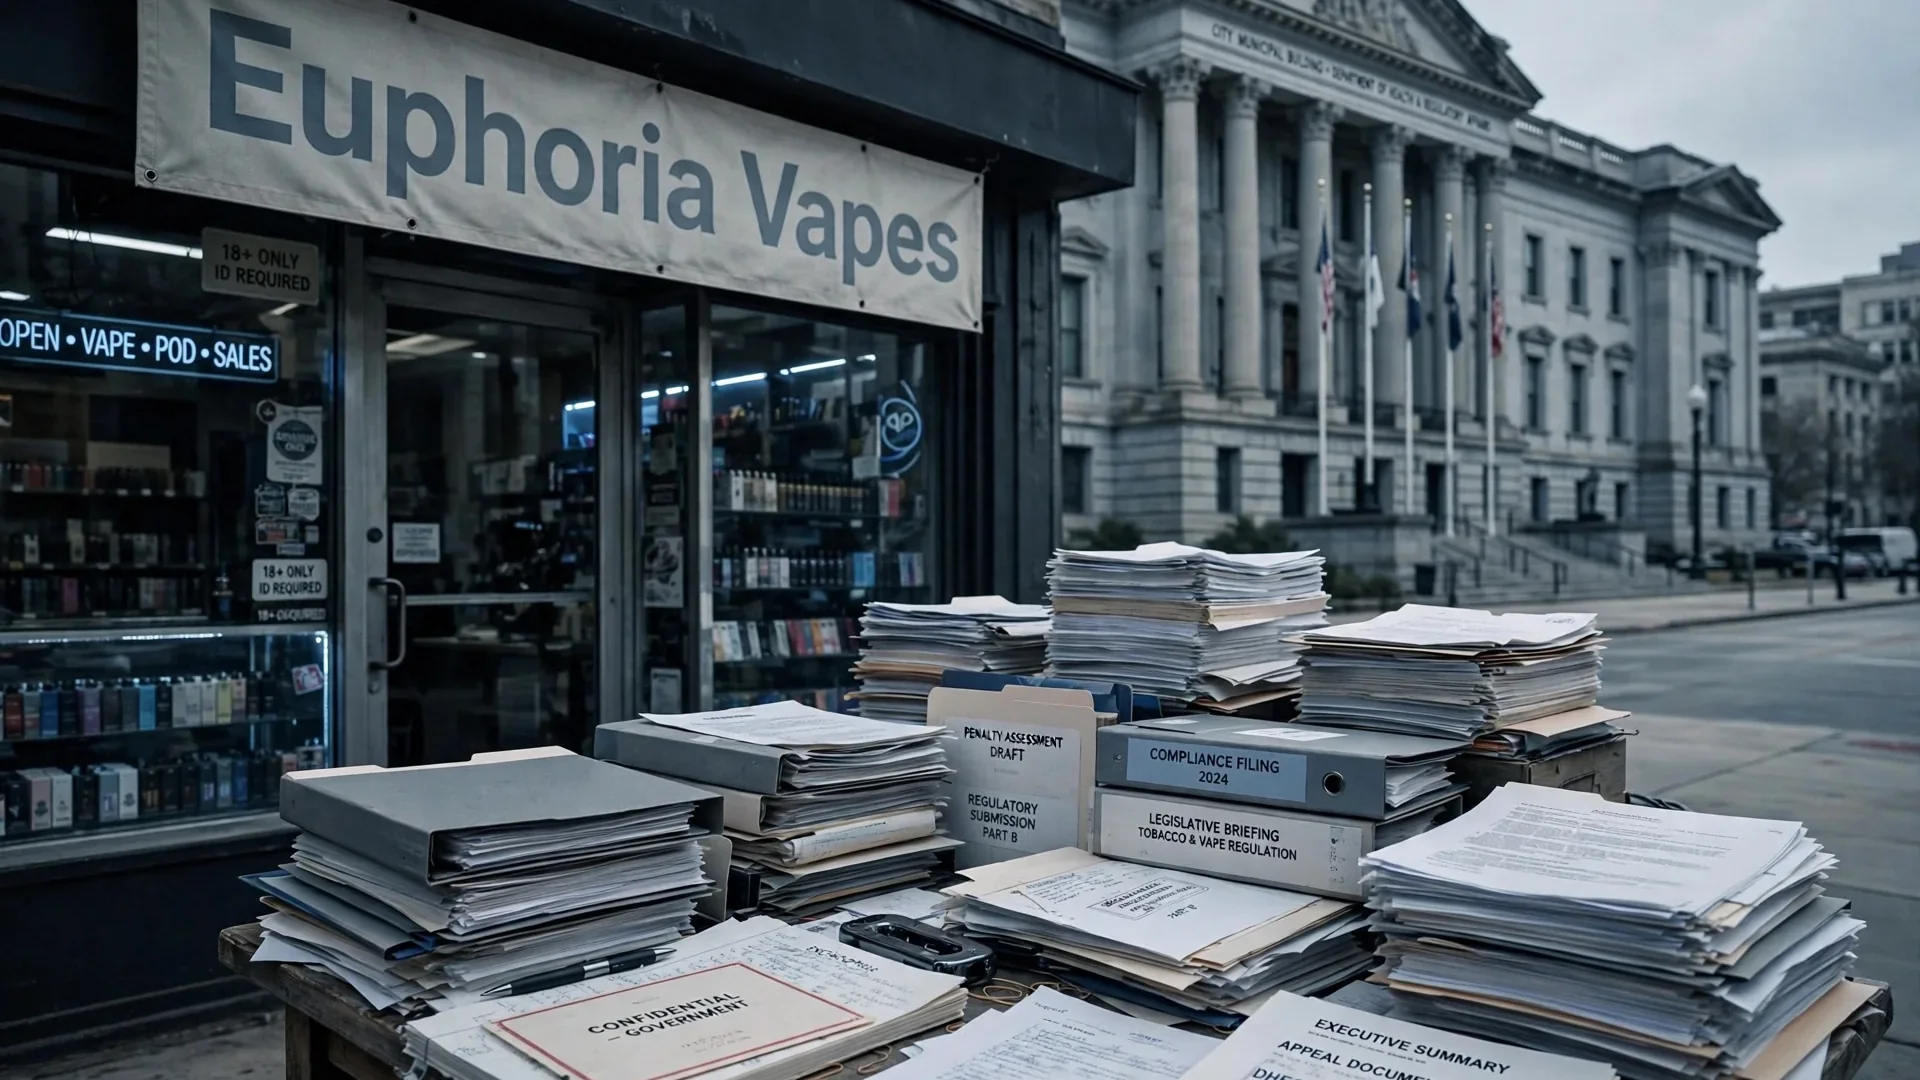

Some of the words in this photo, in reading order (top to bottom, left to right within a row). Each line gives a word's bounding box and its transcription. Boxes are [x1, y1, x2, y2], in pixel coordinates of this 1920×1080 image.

[1211, 24, 1233, 42] CITY
[210, 8, 716, 235] Euphoria
[740, 150, 959, 286] Vapes
[222, 244, 253, 261] 18+
[258, 248, 299, 270] ONLY
[214, 264, 231, 280] ID
[236, 267, 310, 292] REQUIRED
[0, 318, 60, 352] OPEN
[81, 327, 136, 359] VAPE
[155, 335, 196, 364] POD
[213, 341, 272, 372] SALES
[263, 565, 283, 579] 18+
[286, 565, 315, 579] ONLY
[259, 582, 270, 595] ID
[273, 581, 322, 596] REQUIRED
[964, 726, 1003, 742] PENALTY
[1004, 731, 1063, 749] ASSESSMENT
[990, 746, 1025, 761] DRAFT
[1150, 747, 1233, 768] COMPLIANCE
[1236, 757, 1280, 773] FILING
[1198, 771, 1229, 785] 2024
[968, 793, 1038, 815] REGULATORY
[970, 810, 1036, 830] SUBMISSION
[1149, 812, 1220, 834] LEGISLATIVE
[1224, 823, 1280, 842] BRIEFING
[983, 827, 1008, 841] PART
[1011, 832, 1018, 843] B
[1138, 826, 1187, 844] TOBACCO
[1188, 834, 1197, 845] &
[1199, 835, 1226, 850] VAPE
[1228, 840, 1297, 860] REGULATION
[587, 992, 741, 1034] CONFIDENTIAL
[625, 999, 749, 1037] GOVERNMENT
[1314, 1018, 1412, 1051] EXECUTIVE
[1413, 1044, 1511, 1074] SUMMARY
[1277, 1040, 1342, 1066] APPEAL
[1346, 1059, 1430, 1080] DOCUM
